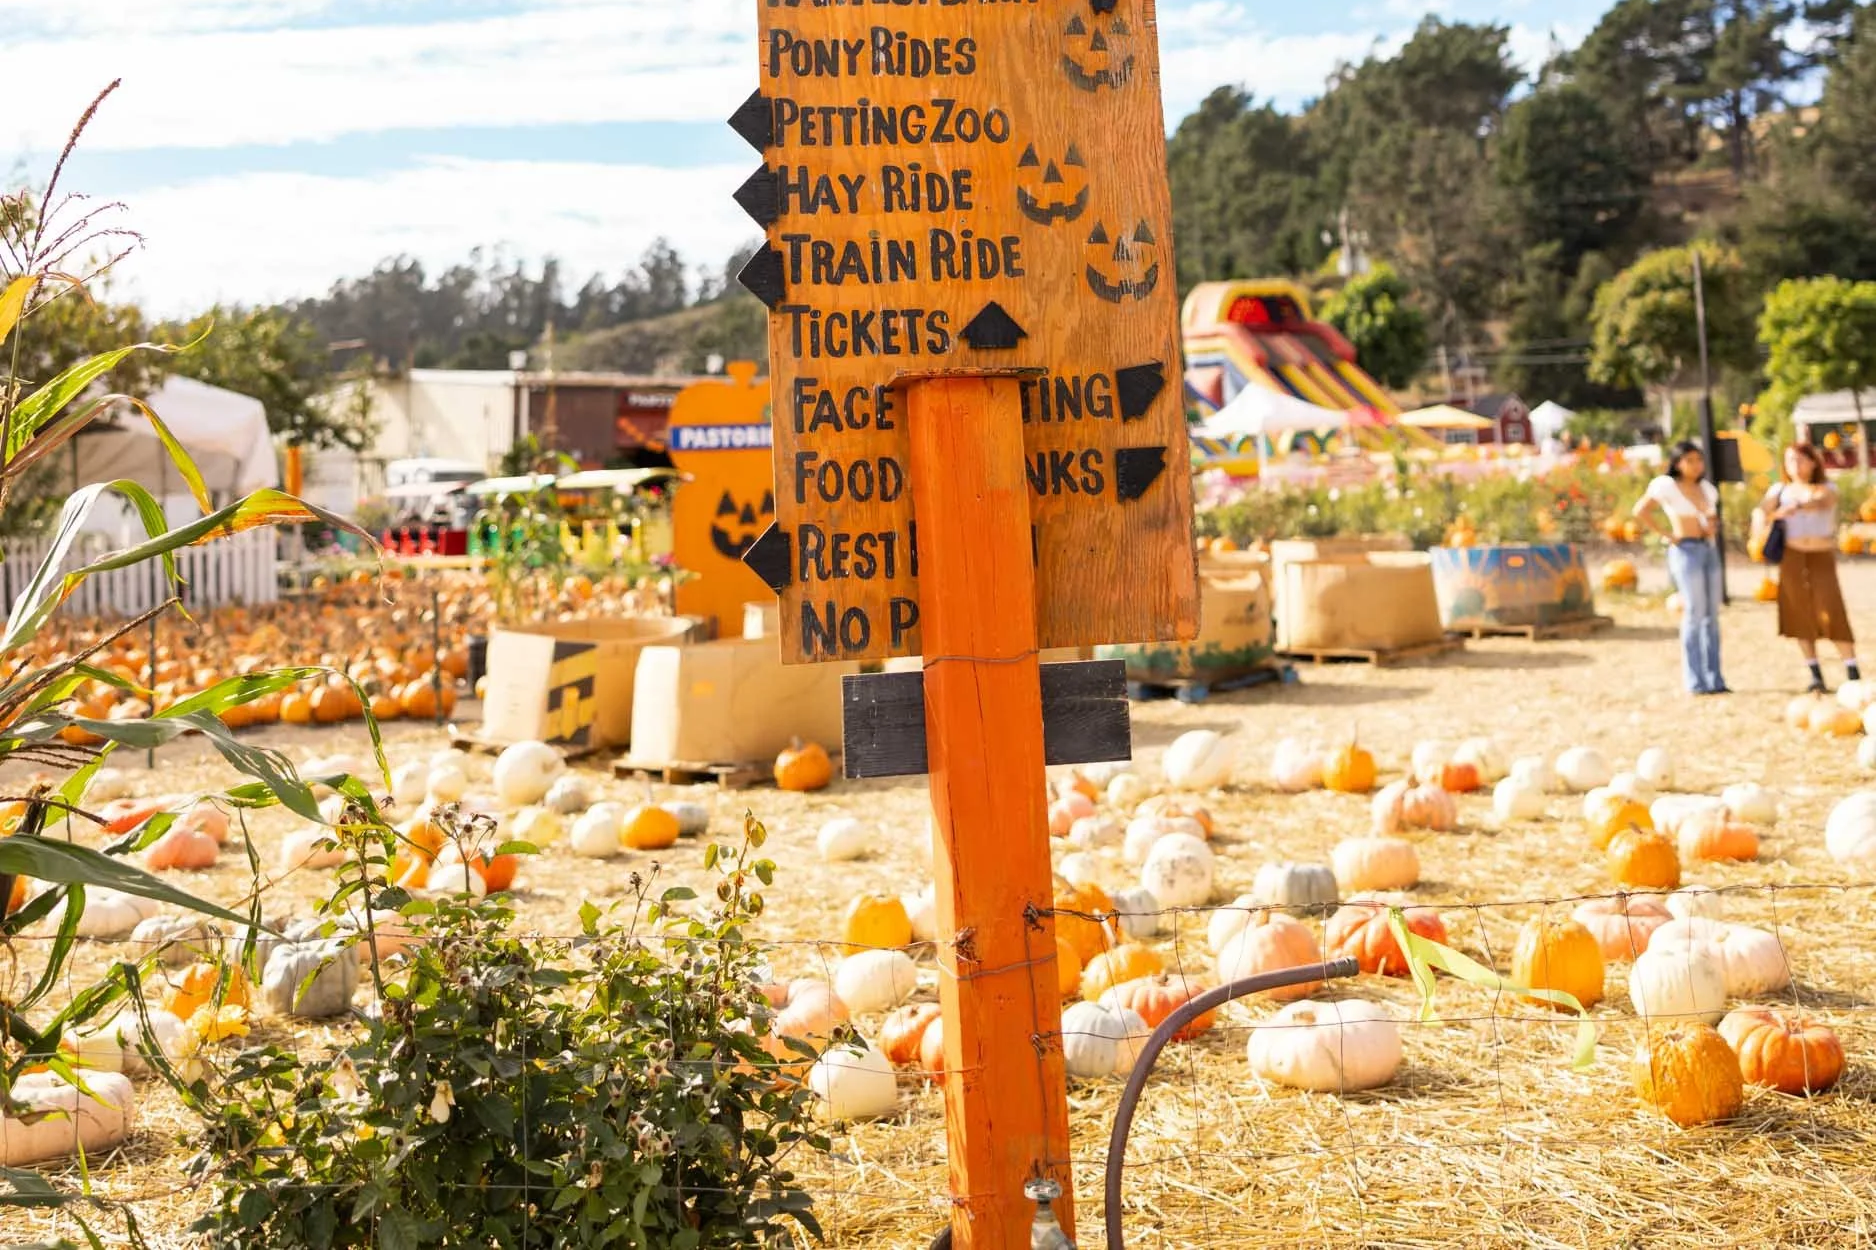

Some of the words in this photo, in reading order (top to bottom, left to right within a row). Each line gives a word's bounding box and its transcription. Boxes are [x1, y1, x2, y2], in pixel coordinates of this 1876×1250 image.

[769, 29, 865, 78] PONY
[870, 25, 977, 78] RIDES
[773, 97, 926, 147] PETTING
[930, 98, 1011, 144] ZOO
[776, 165, 866, 215] HAY
[882, 162, 973, 214] RIDE
[780, 230, 917, 286] TRAIN
[930, 229, 1026, 282] RIDE
[780, 304, 950, 359] TICKETS
[793, 377, 895, 434] FACE
[1019, 372, 1114, 424] TING
[679, 425, 774, 448] PASTORI
[795, 451, 903, 504] FOOD
[1024, 448, 1105, 496] NKS
[798, 523, 897, 582] REST
[801, 598, 871, 656] NO
